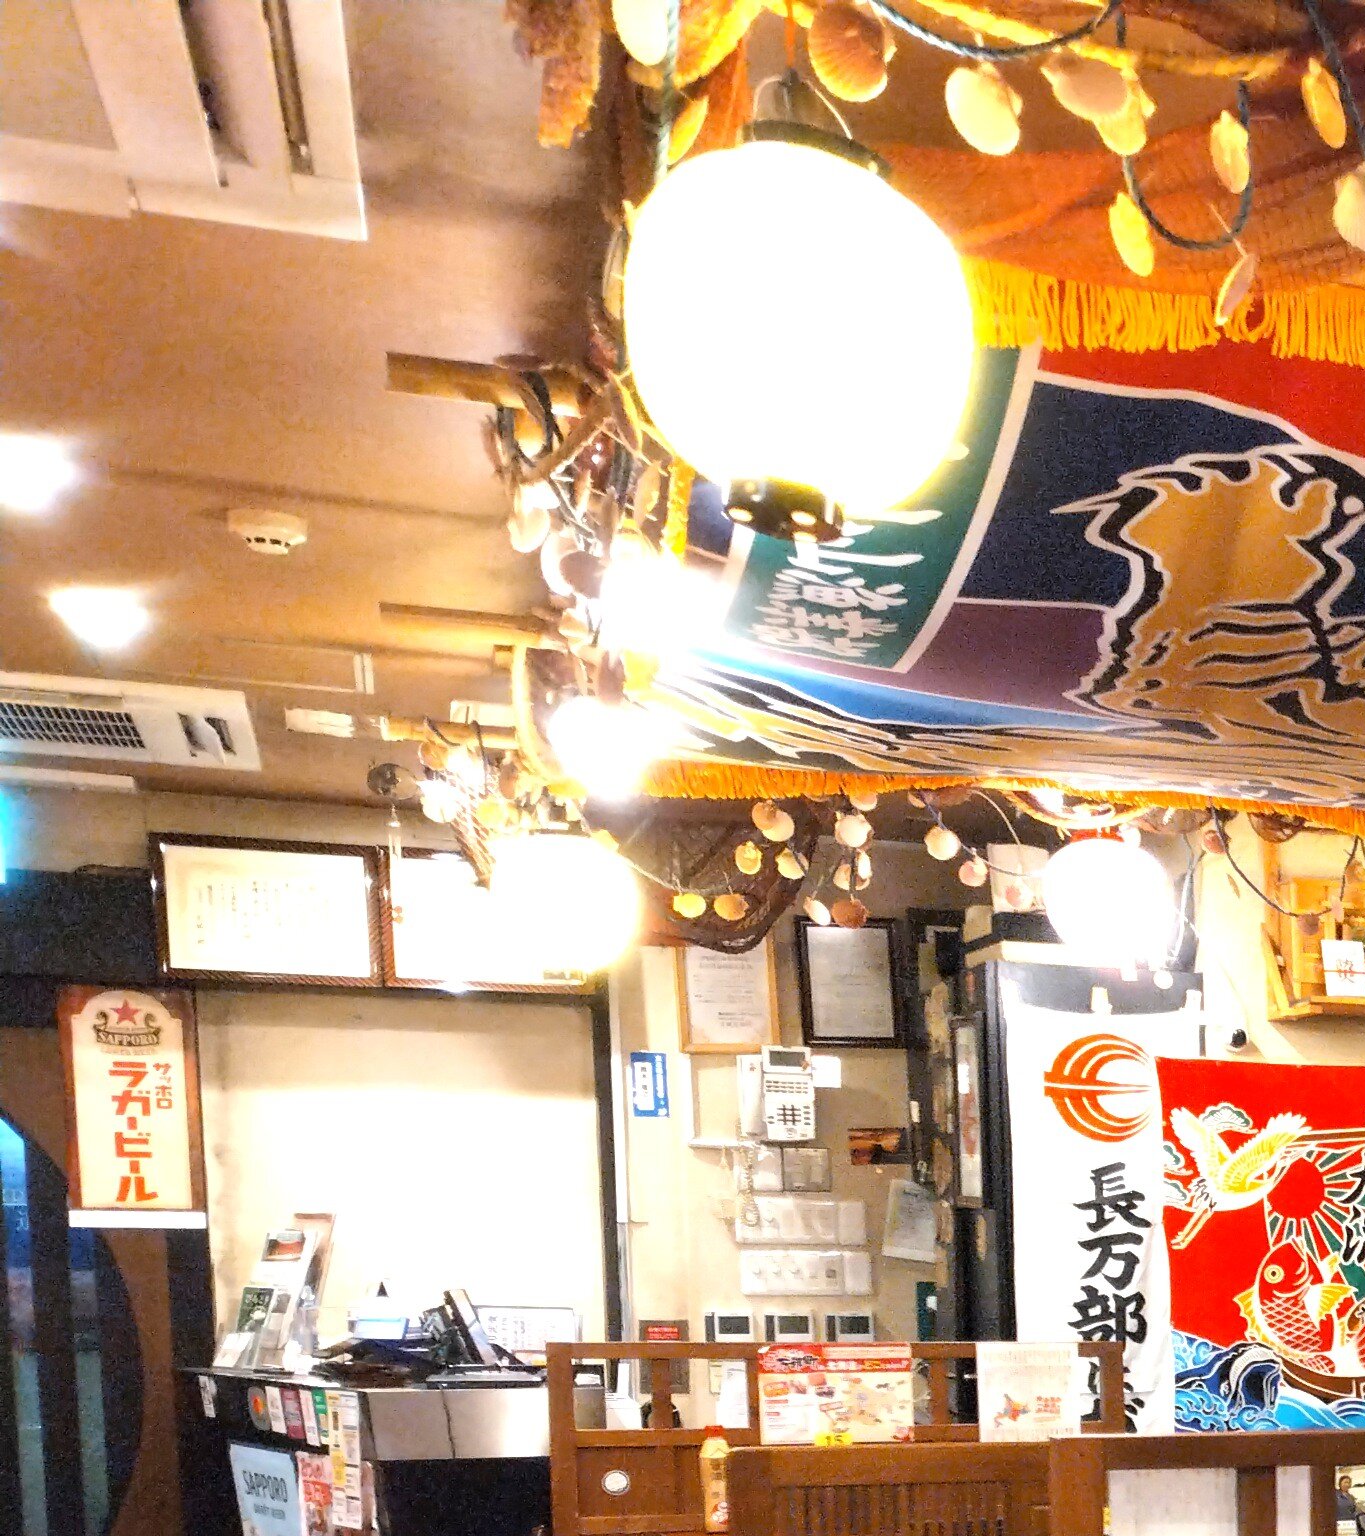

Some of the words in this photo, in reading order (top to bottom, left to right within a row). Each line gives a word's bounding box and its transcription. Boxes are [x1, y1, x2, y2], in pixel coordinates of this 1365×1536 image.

[98, 1033, 159, 1047] SAPPORO
[153, 1062, 172, 1109] サッポロ
[109, 1060, 158, 1202] ラガービール
